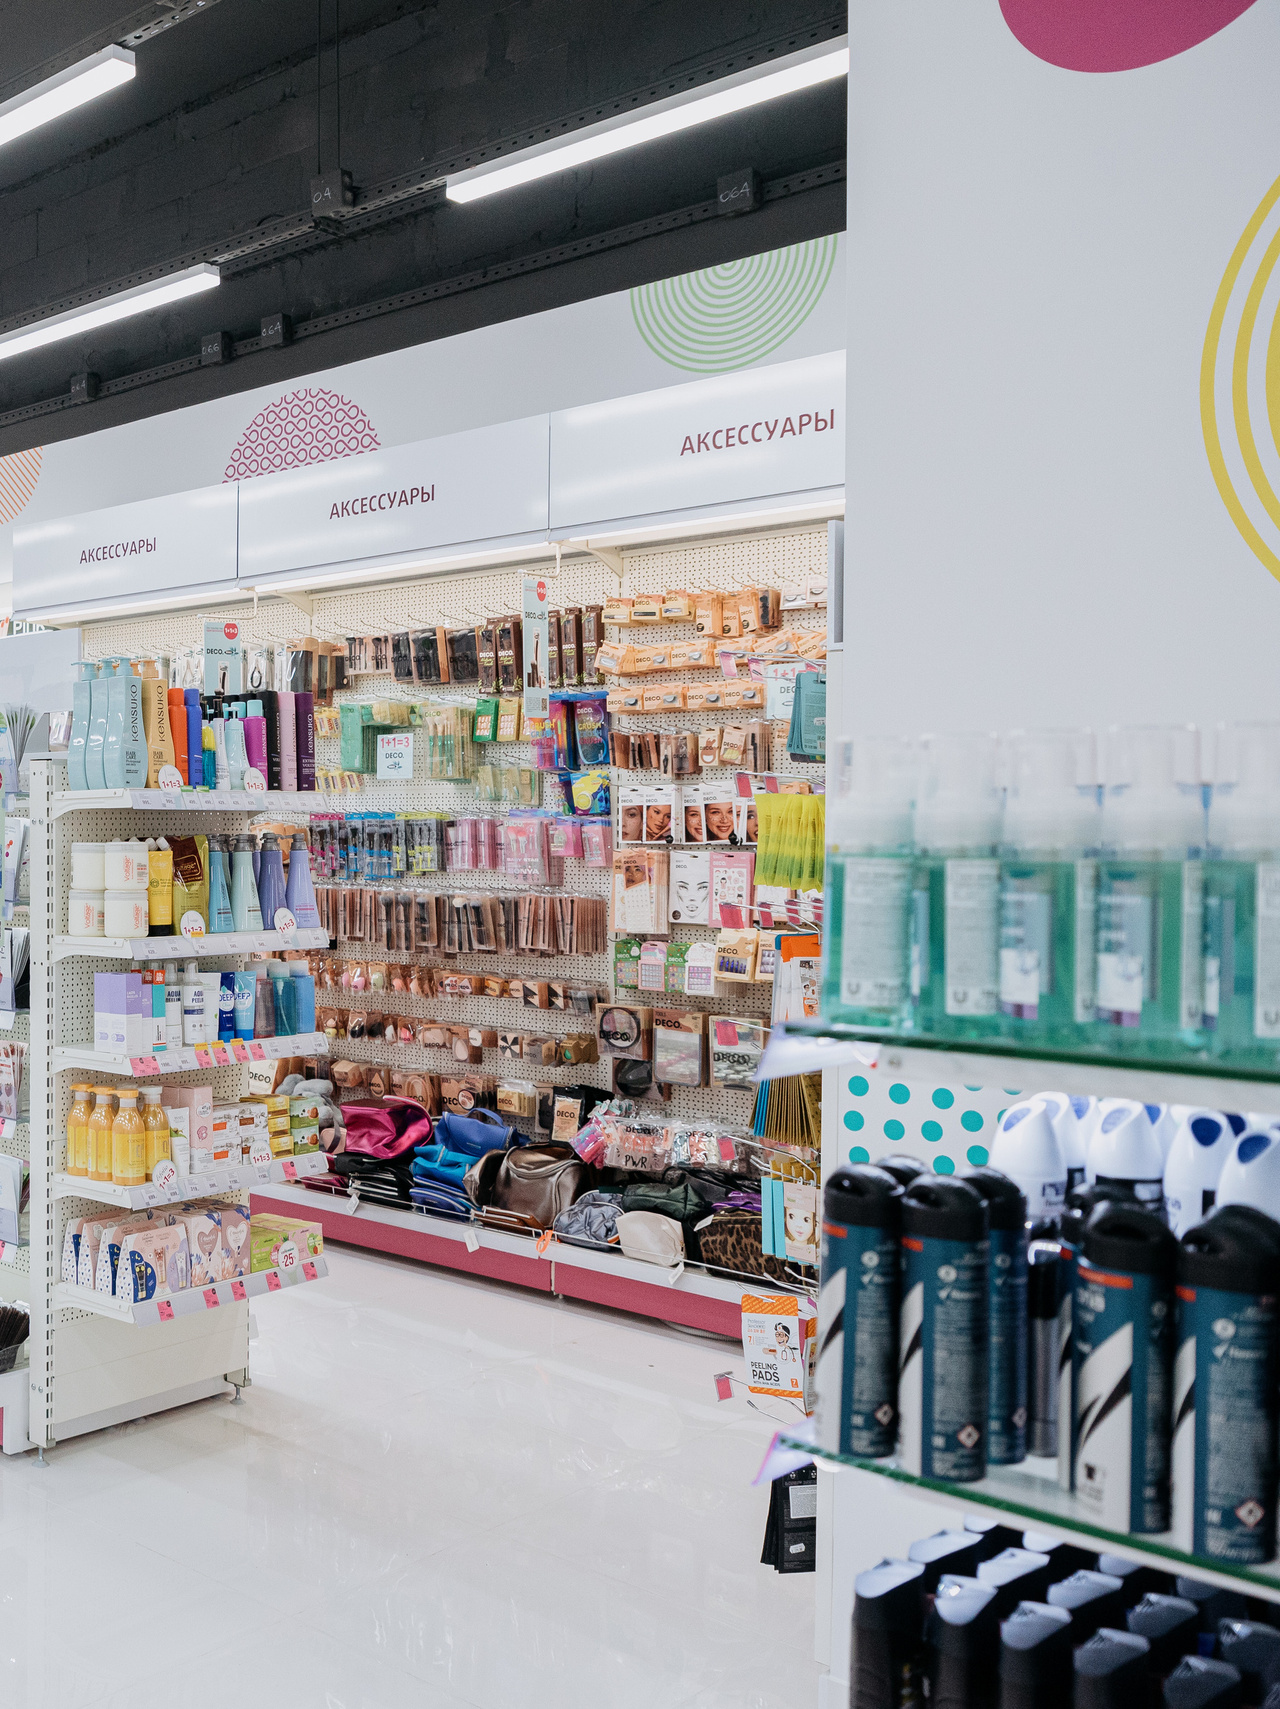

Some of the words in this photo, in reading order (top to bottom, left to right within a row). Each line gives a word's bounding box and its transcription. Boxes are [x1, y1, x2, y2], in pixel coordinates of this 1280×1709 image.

[679, 408, 835, 457] АКСЕССУАРЫ
[328, 483, 436, 520] АКСЕССУАРЫ
[78, 535, 157, 565] АКСЕССУАРЫ
[800, 645, 818, 656] DECO.
[131, 684, 139, 742] KENSUKO
[530, 721, 555, 730] CRUSH
[531, 730, 555, 738] CRUSH
[381, 737, 410, 748] 1+1=3
[531, 738, 556, 746] CRUSH
[161, 780, 181, 790] 1+1=3
[246, 781, 264, 790] 1+1=3
[124, 855, 132, 882] Voltage
[278, 918, 295, 934] 1+1=3
[717, 947, 739, 955] DECO.
[655, 1018, 682, 1029] DECO.
[556, 1110, 575, 1118] DECO.
[253, 1153, 270, 1164] 1+1=3
[625, 1155, 647, 1168] PWR
[159, 1168, 175, 1190] 1+1=3
[750, 1361, 778, 1371] PEELING
[752, 1369, 780, 1382] PADS
